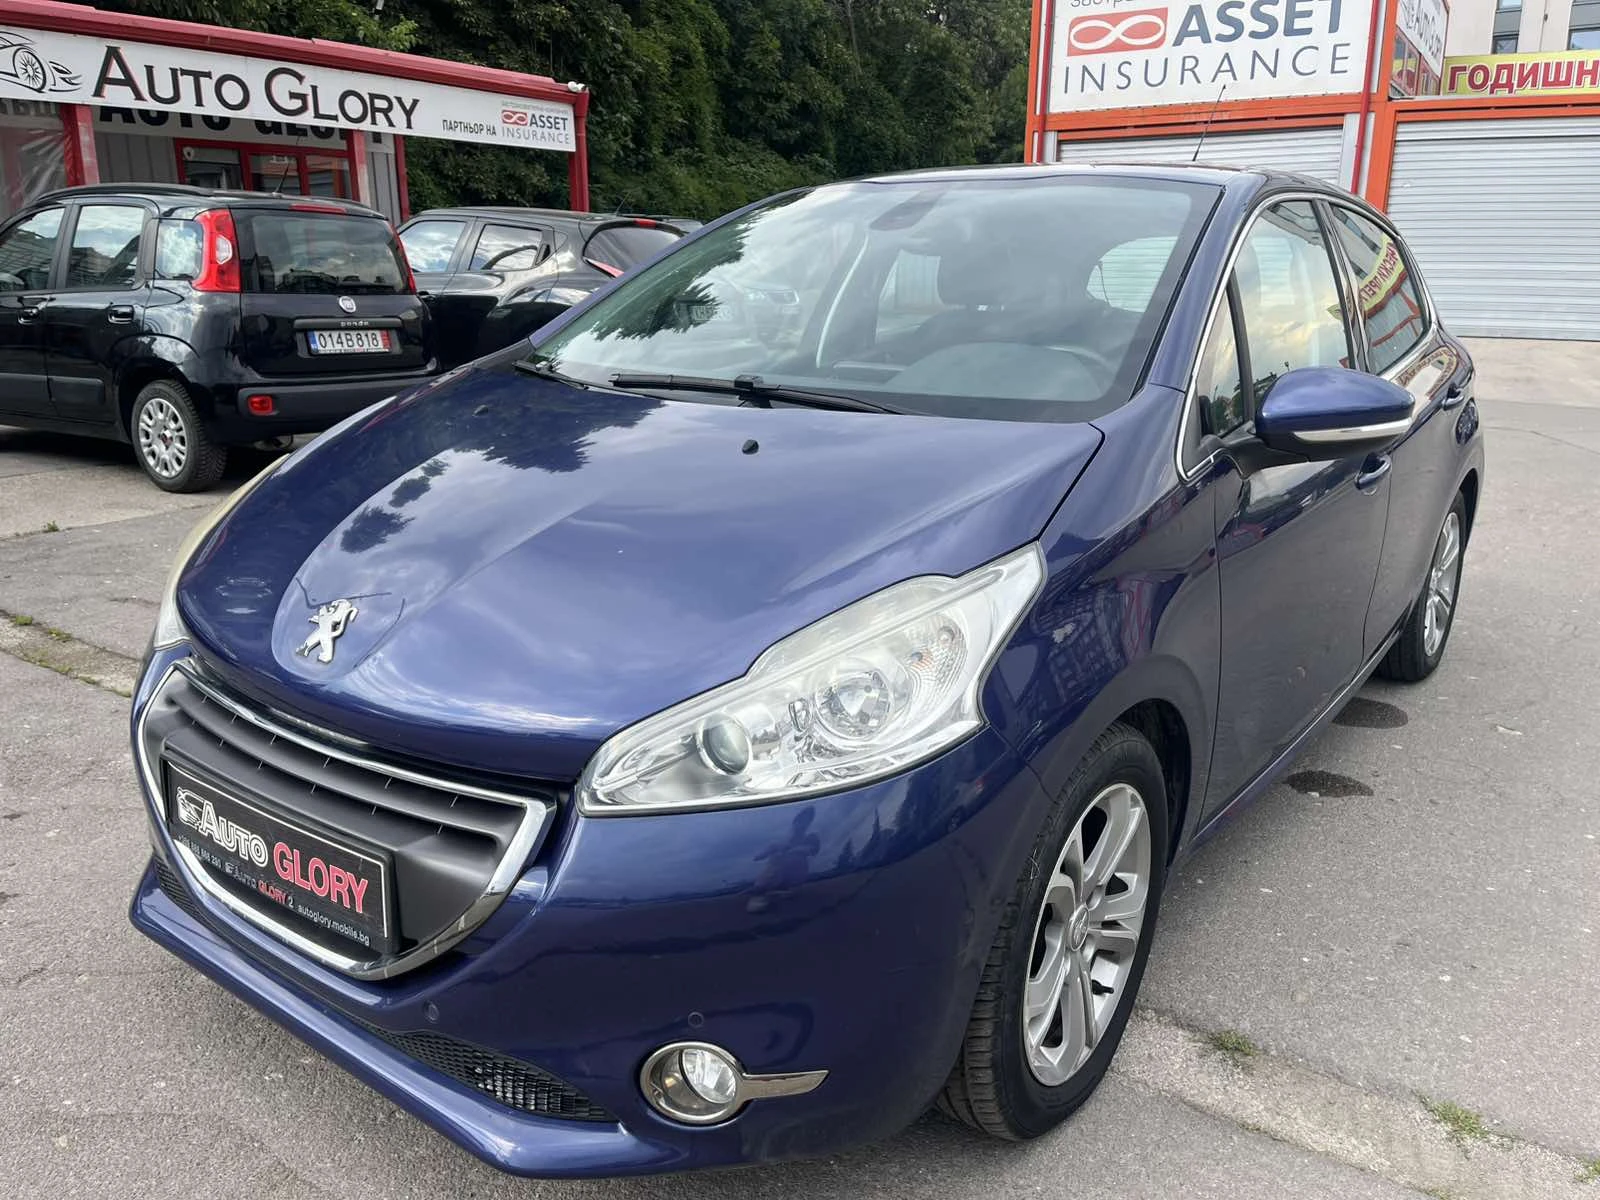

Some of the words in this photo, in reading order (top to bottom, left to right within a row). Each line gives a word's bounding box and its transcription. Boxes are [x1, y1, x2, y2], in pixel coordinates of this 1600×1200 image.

[1172, 0, 1341, 47] ASSET
[1064, 43, 1350, 94] INSURANCE
[442, 119, 484, 134] ПАРТНЬОР
[486, 124, 497, 136] НА
[502, 127, 569, 144] INSURANCE
[529, 113, 568, 131] ASSET
[273, 841, 369, 913] GLORY
[287, 895, 295, 909] 2
[297, 903, 370, 947] autoglory.mobile.bg
